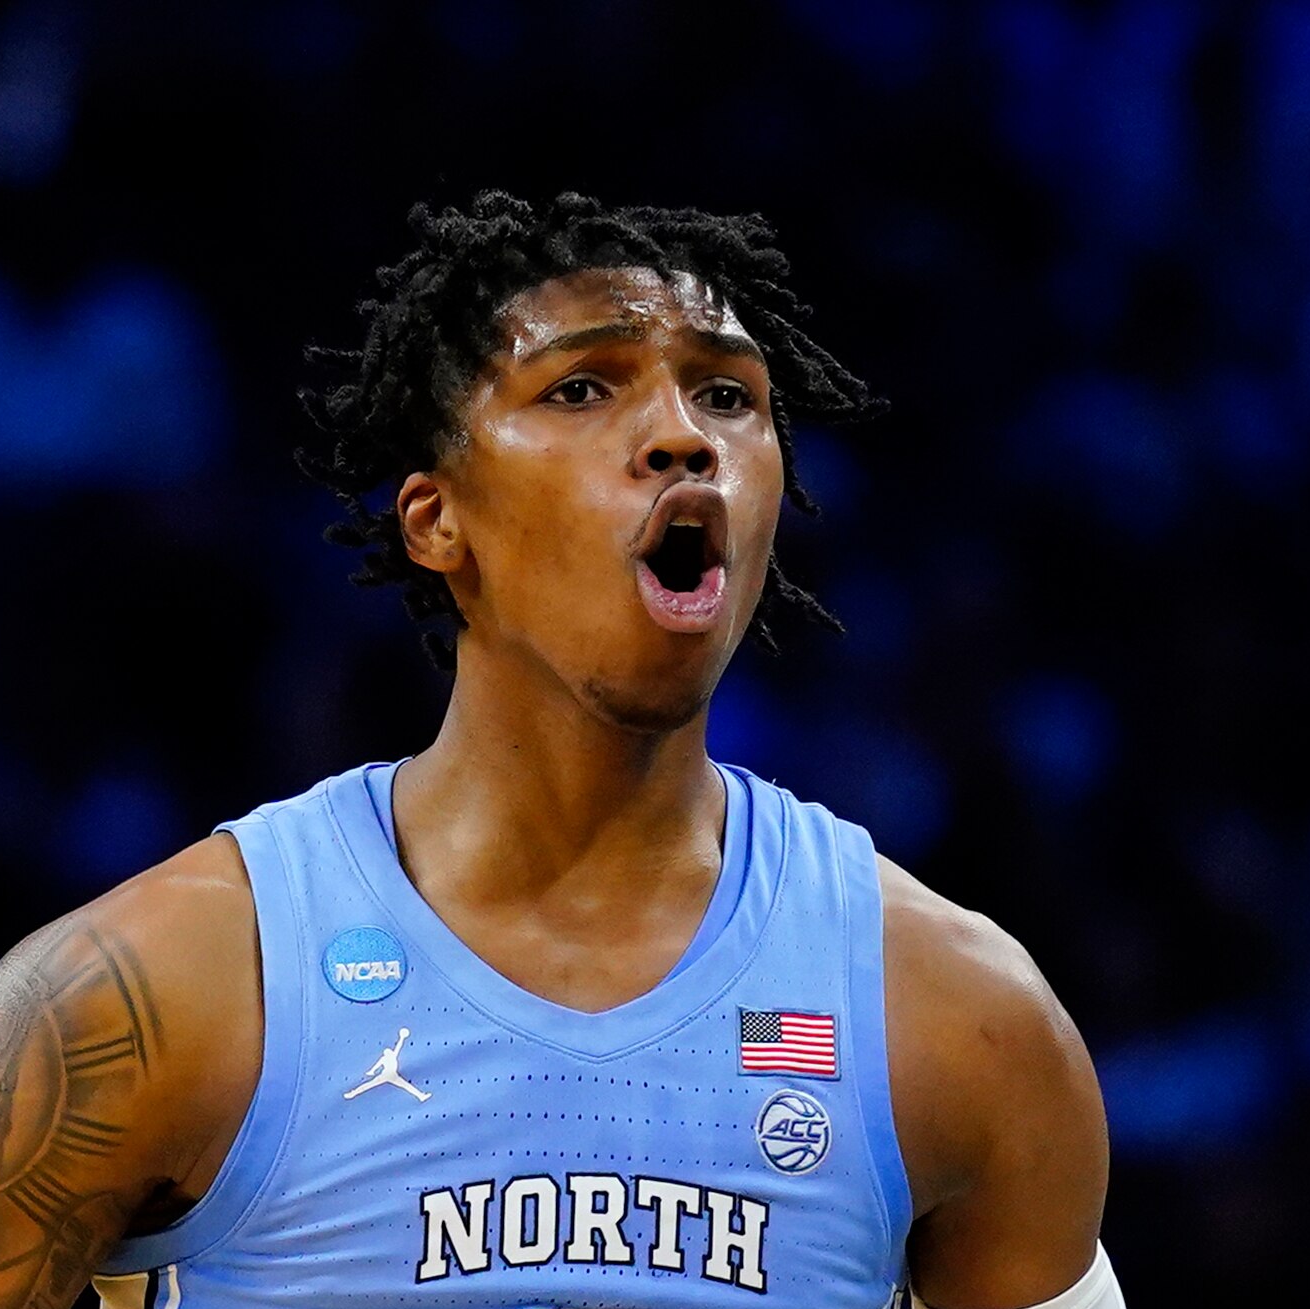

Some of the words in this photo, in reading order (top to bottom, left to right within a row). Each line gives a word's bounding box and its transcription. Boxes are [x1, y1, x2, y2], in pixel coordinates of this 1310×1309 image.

[334, 959, 401, 982] NCAA
[768, 1118, 826, 1139] ACC
[415, 1174, 770, 1294] NORTH
